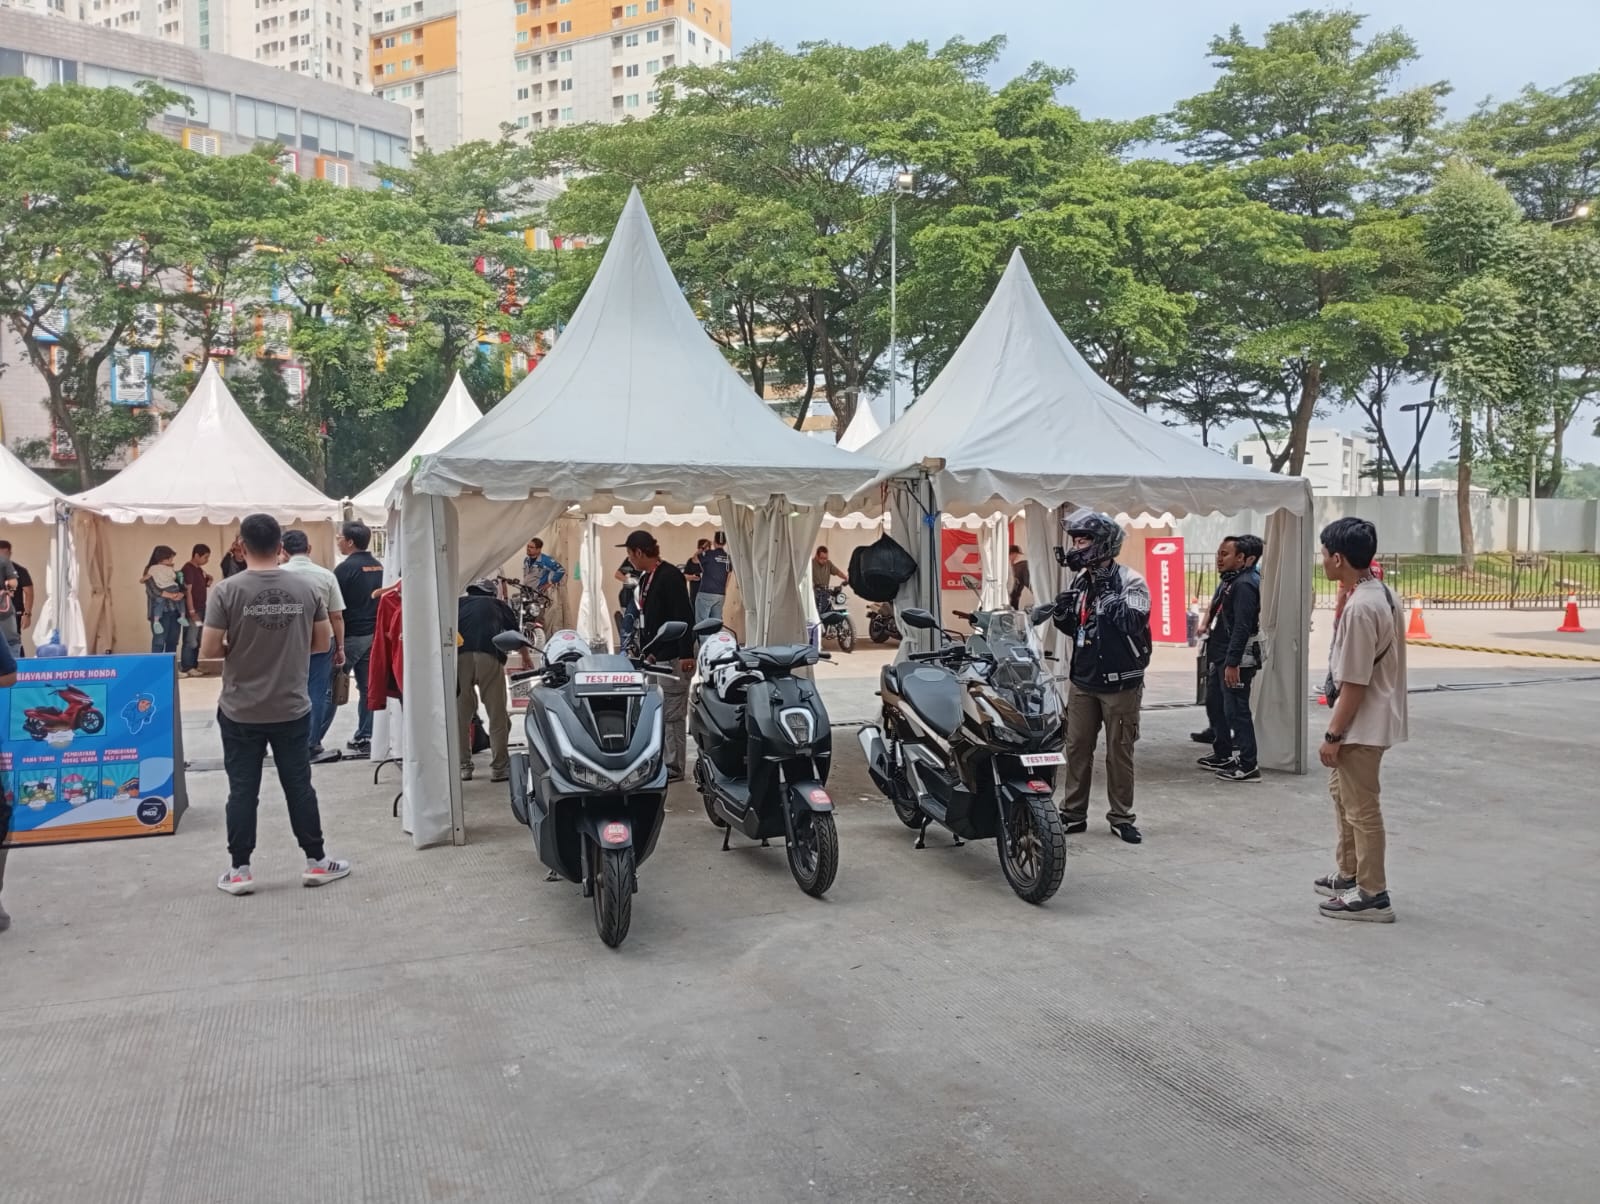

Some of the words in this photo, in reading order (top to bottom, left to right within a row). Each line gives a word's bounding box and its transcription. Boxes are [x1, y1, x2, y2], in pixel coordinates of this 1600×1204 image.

[1160, 560, 1171, 635] QJMOTOR
[55, 670, 86, 680] MOTOR
[88, 668, 117, 678] HONDA
[585, 675, 608, 683] TEST
[612, 675, 636, 683] RIDE
